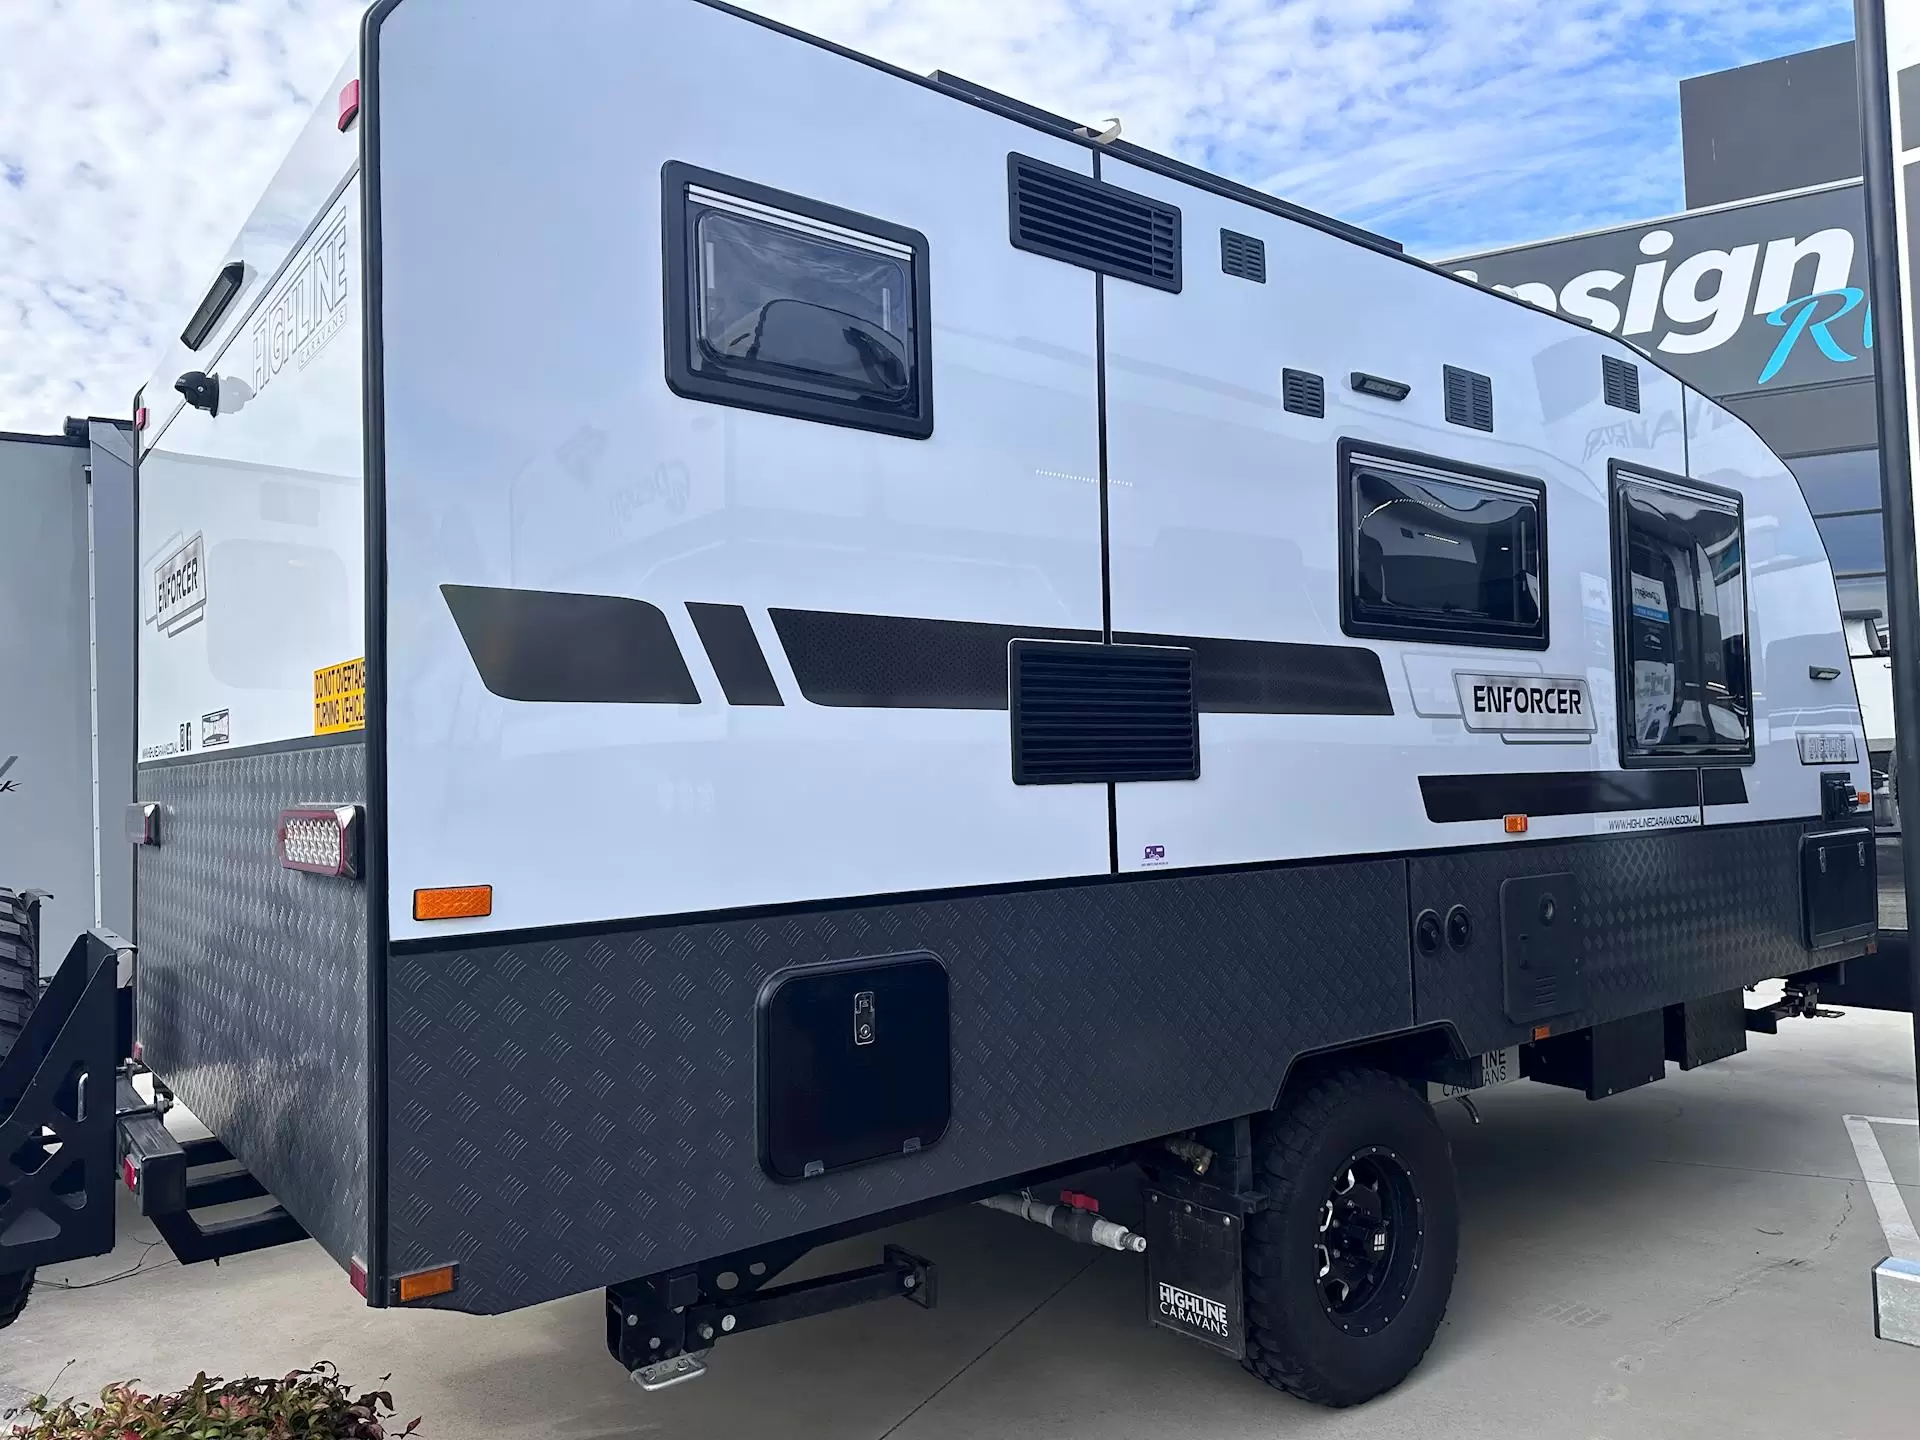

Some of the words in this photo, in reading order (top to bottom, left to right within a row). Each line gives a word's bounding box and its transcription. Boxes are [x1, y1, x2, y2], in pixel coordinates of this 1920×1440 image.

[253, 206, 347, 399] HIGHLINE
[299, 310, 345, 364] CARAVANS
[159, 557, 198, 613] ENFORCER
[316, 673, 323, 699] DO
[324, 669, 335, 696] NOT
[1473, 685, 1581, 714] ENFORCER
[316, 699, 340, 728] TURNING
[1159, 1281, 1228, 1325] HIGHLINE
[1159, 1301, 1229, 1338] CARAVANS
